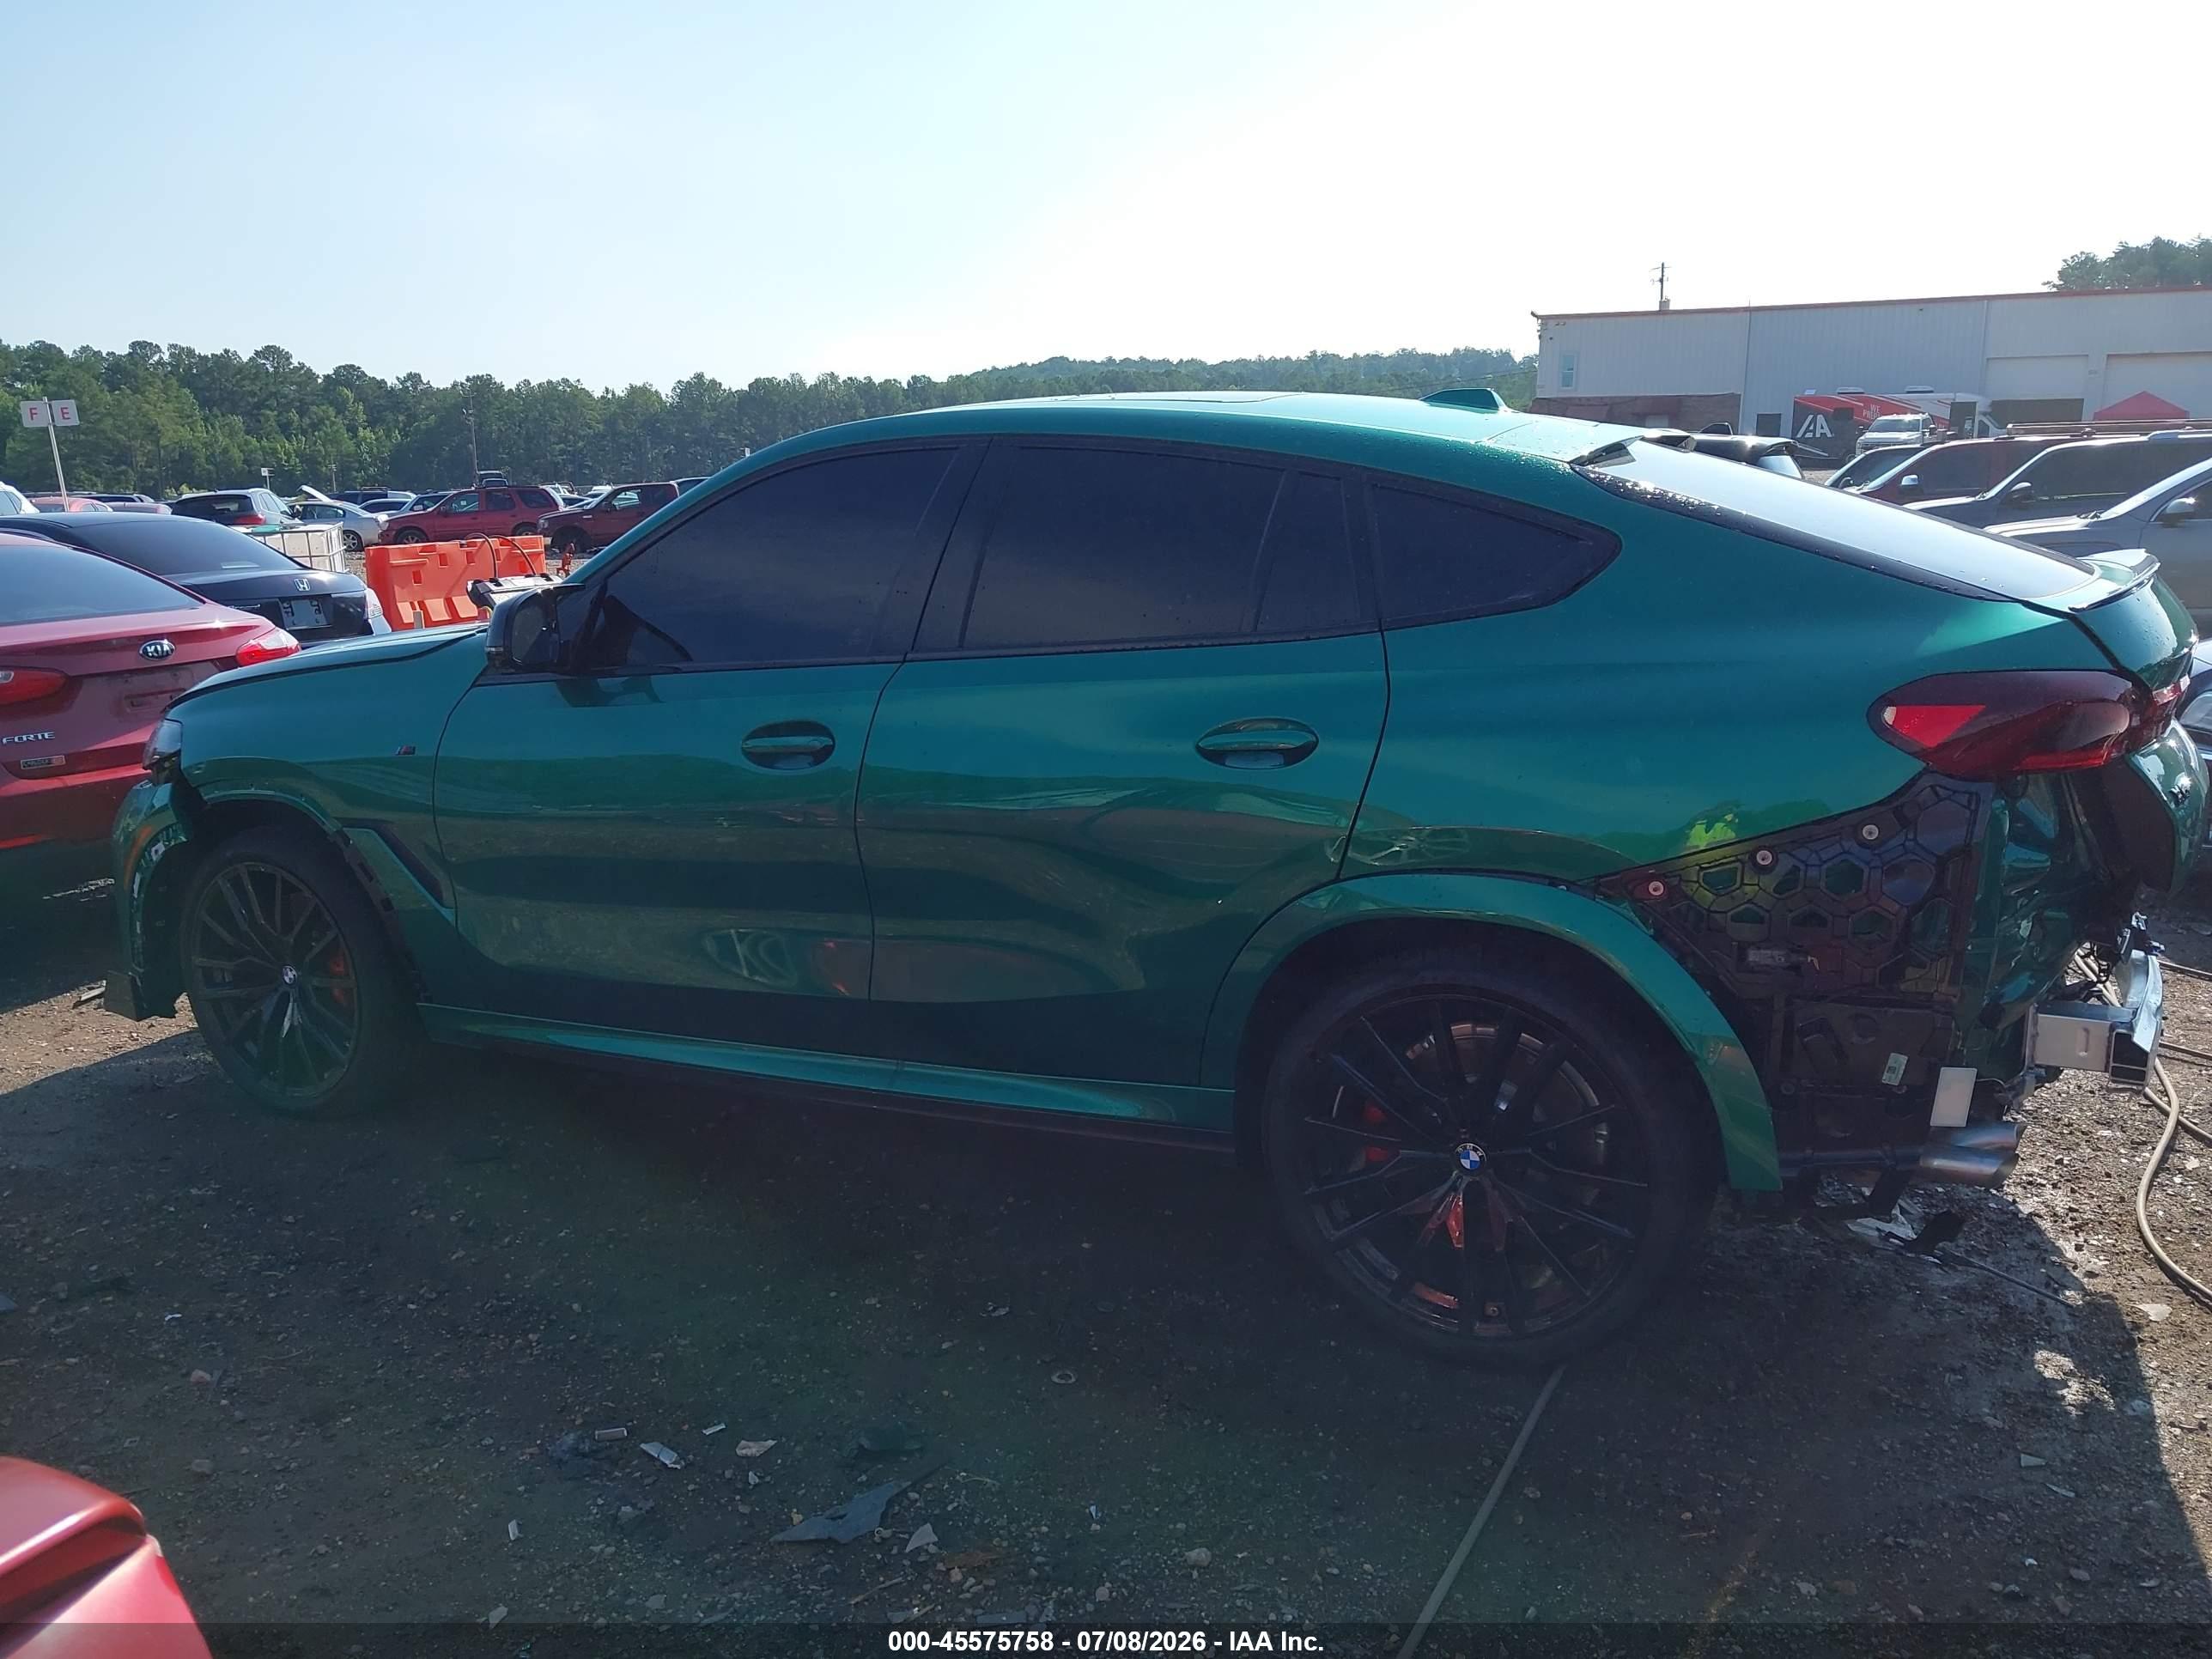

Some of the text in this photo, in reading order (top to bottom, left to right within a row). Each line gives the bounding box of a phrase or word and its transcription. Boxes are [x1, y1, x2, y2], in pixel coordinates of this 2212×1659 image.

[29, 407, 38, 421] F
[60, 407, 70, 420] E
[2, 732, 56, 744] FORTE
